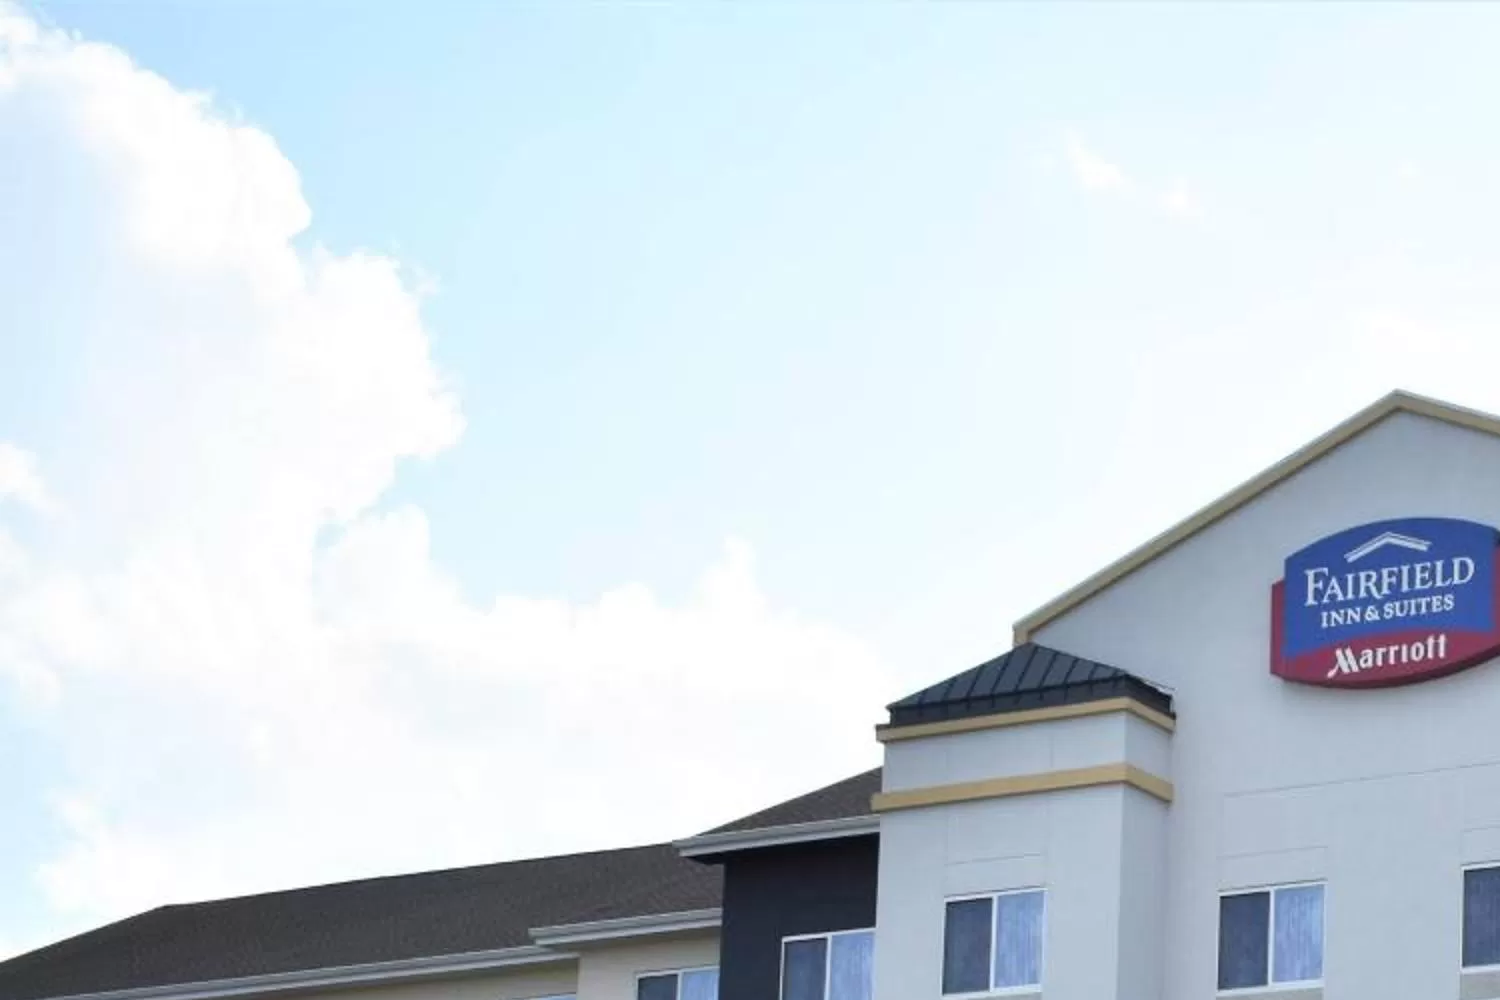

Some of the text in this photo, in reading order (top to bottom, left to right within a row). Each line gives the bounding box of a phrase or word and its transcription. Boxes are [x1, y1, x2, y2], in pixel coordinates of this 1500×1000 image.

[1304, 557, 1475, 607] FAIRFIELD
[1320, 606, 1361, 628] INN
[1383, 594, 1455, 620] SUITES
[1327, 633, 1448, 678] Marriott
